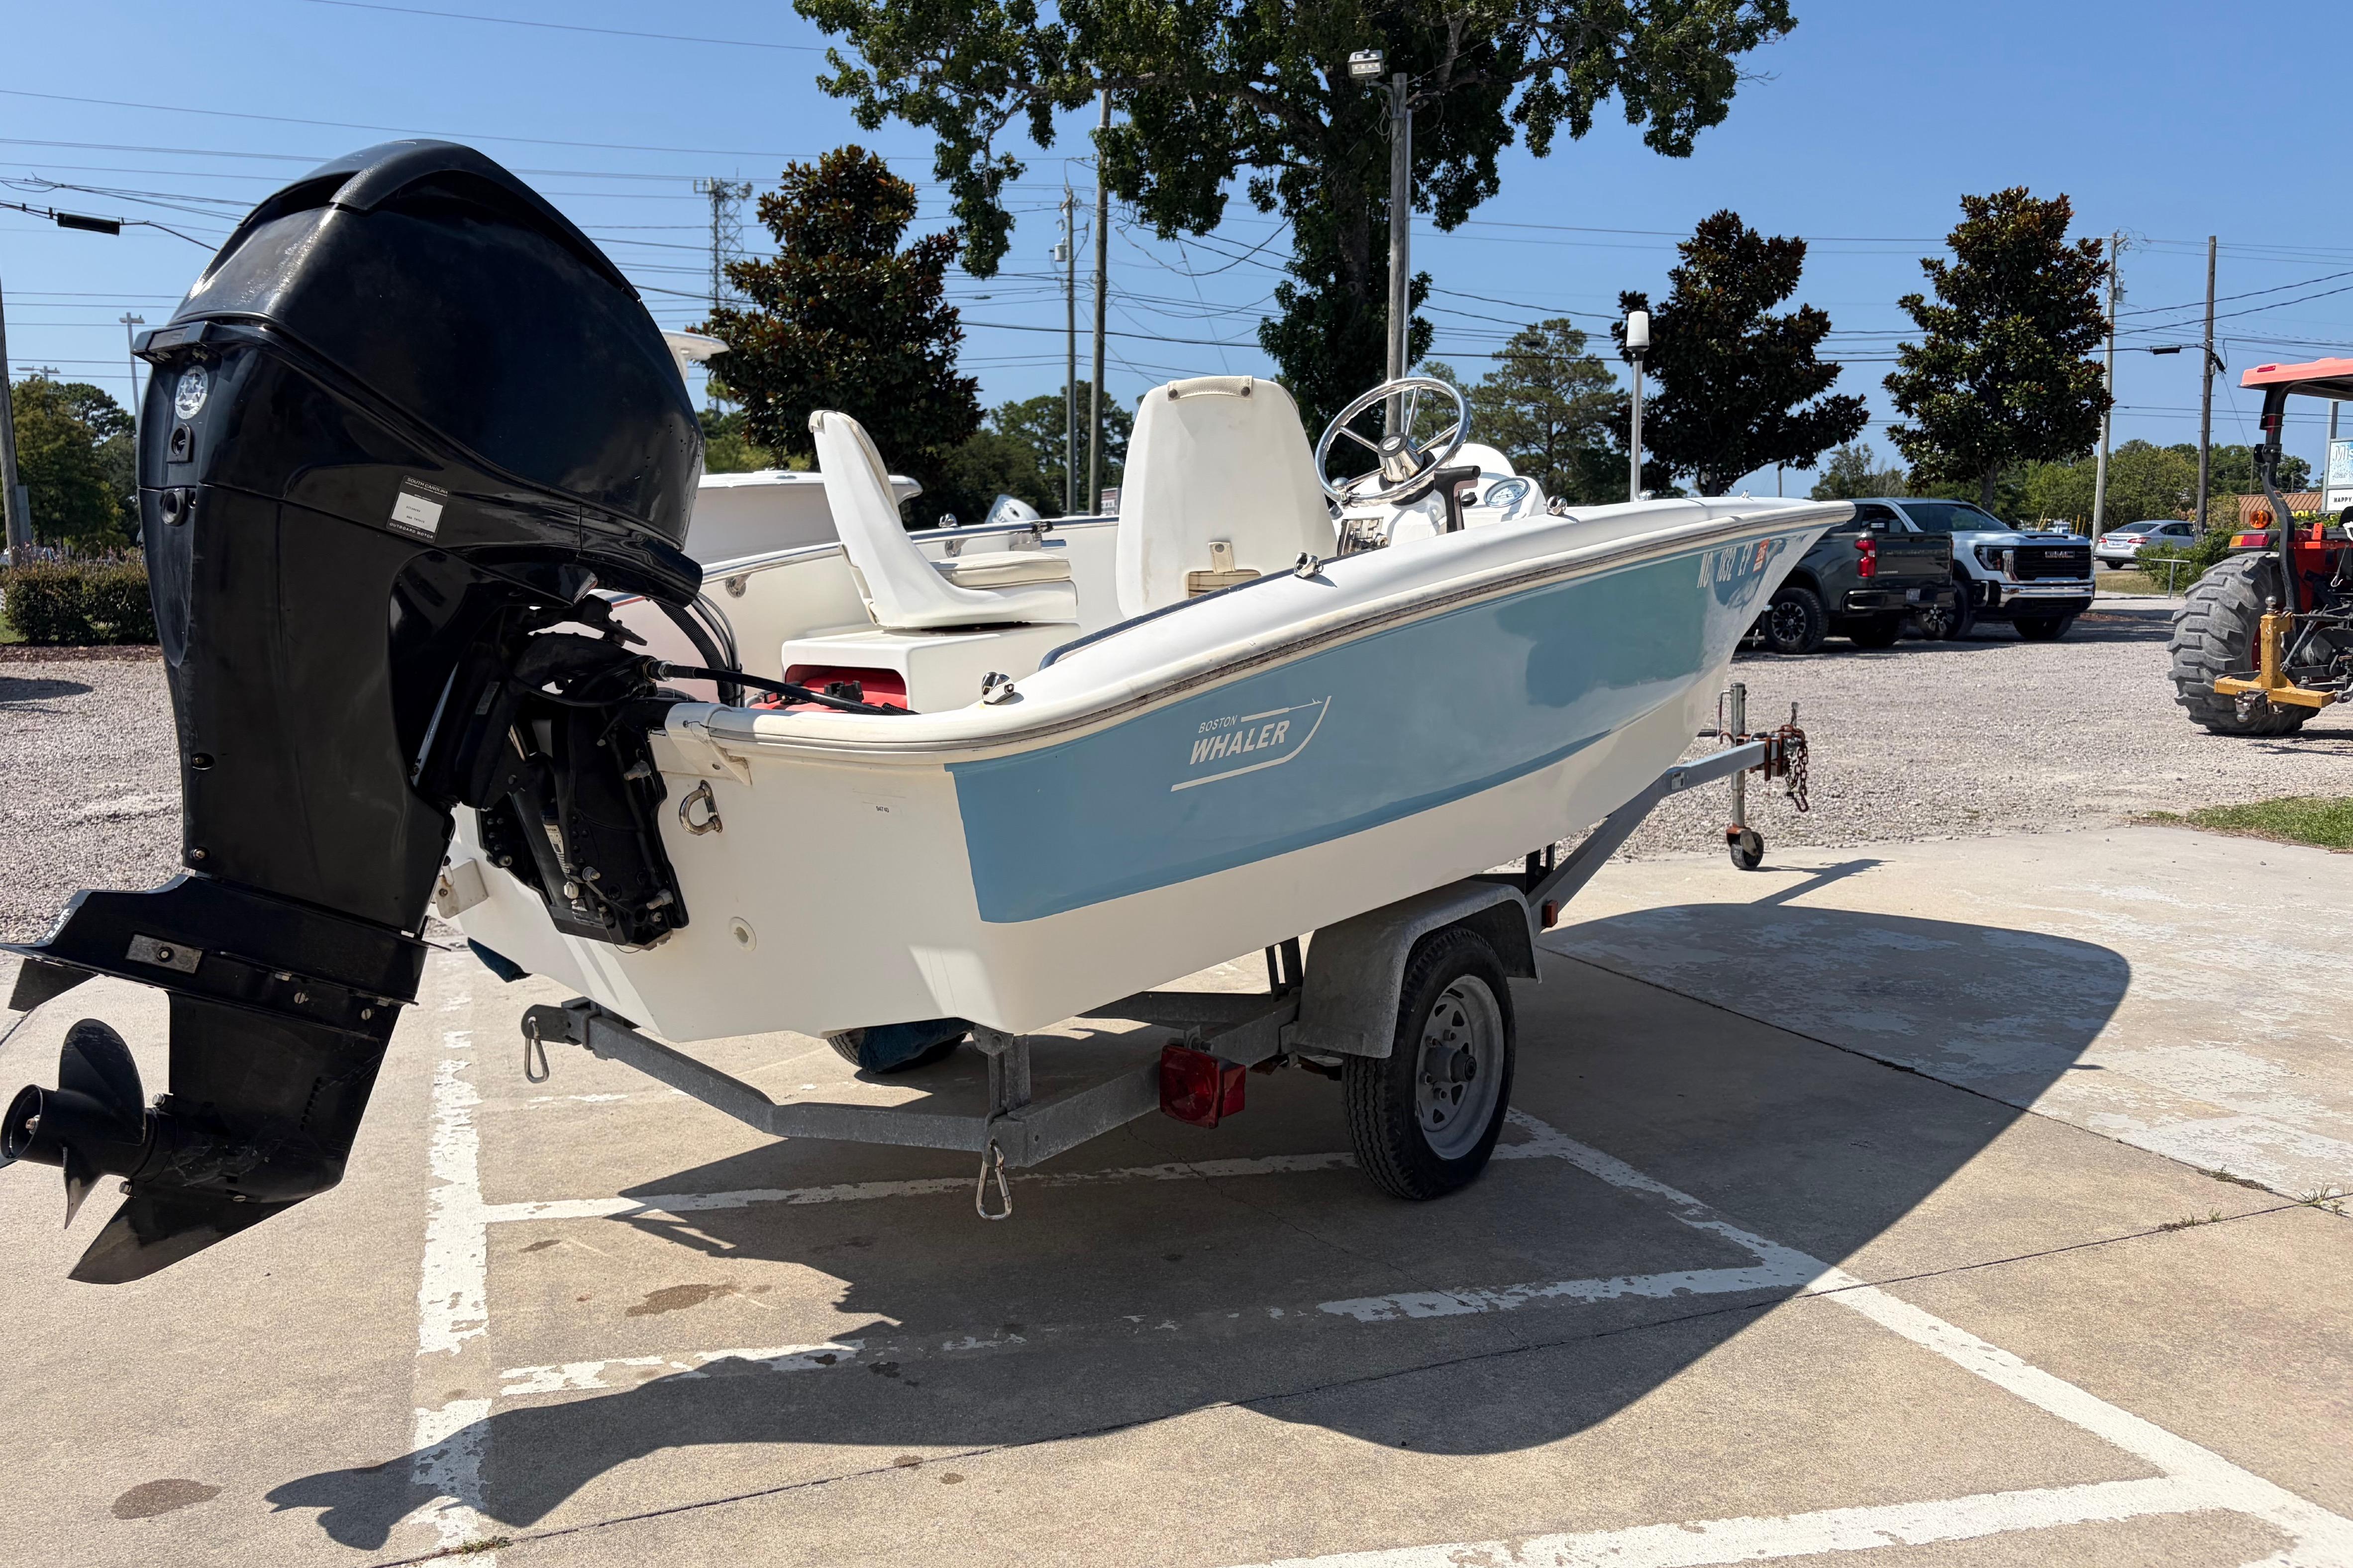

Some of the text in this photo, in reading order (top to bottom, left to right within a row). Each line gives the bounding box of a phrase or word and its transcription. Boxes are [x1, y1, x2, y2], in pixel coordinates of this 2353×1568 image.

[407, 478, 424, 487] SOUTH
[424, 484, 448, 494] CAROLINA
[389, 522, 416, 533] OUTBOARD
[417, 531, 433, 539] MOTOR
[1697, 552, 1713, 588] NC
[1716, 547, 1737, 582] 1832
[1198, 715, 1238, 733] BOSTON
[1190, 720, 1290, 765] WHALER
